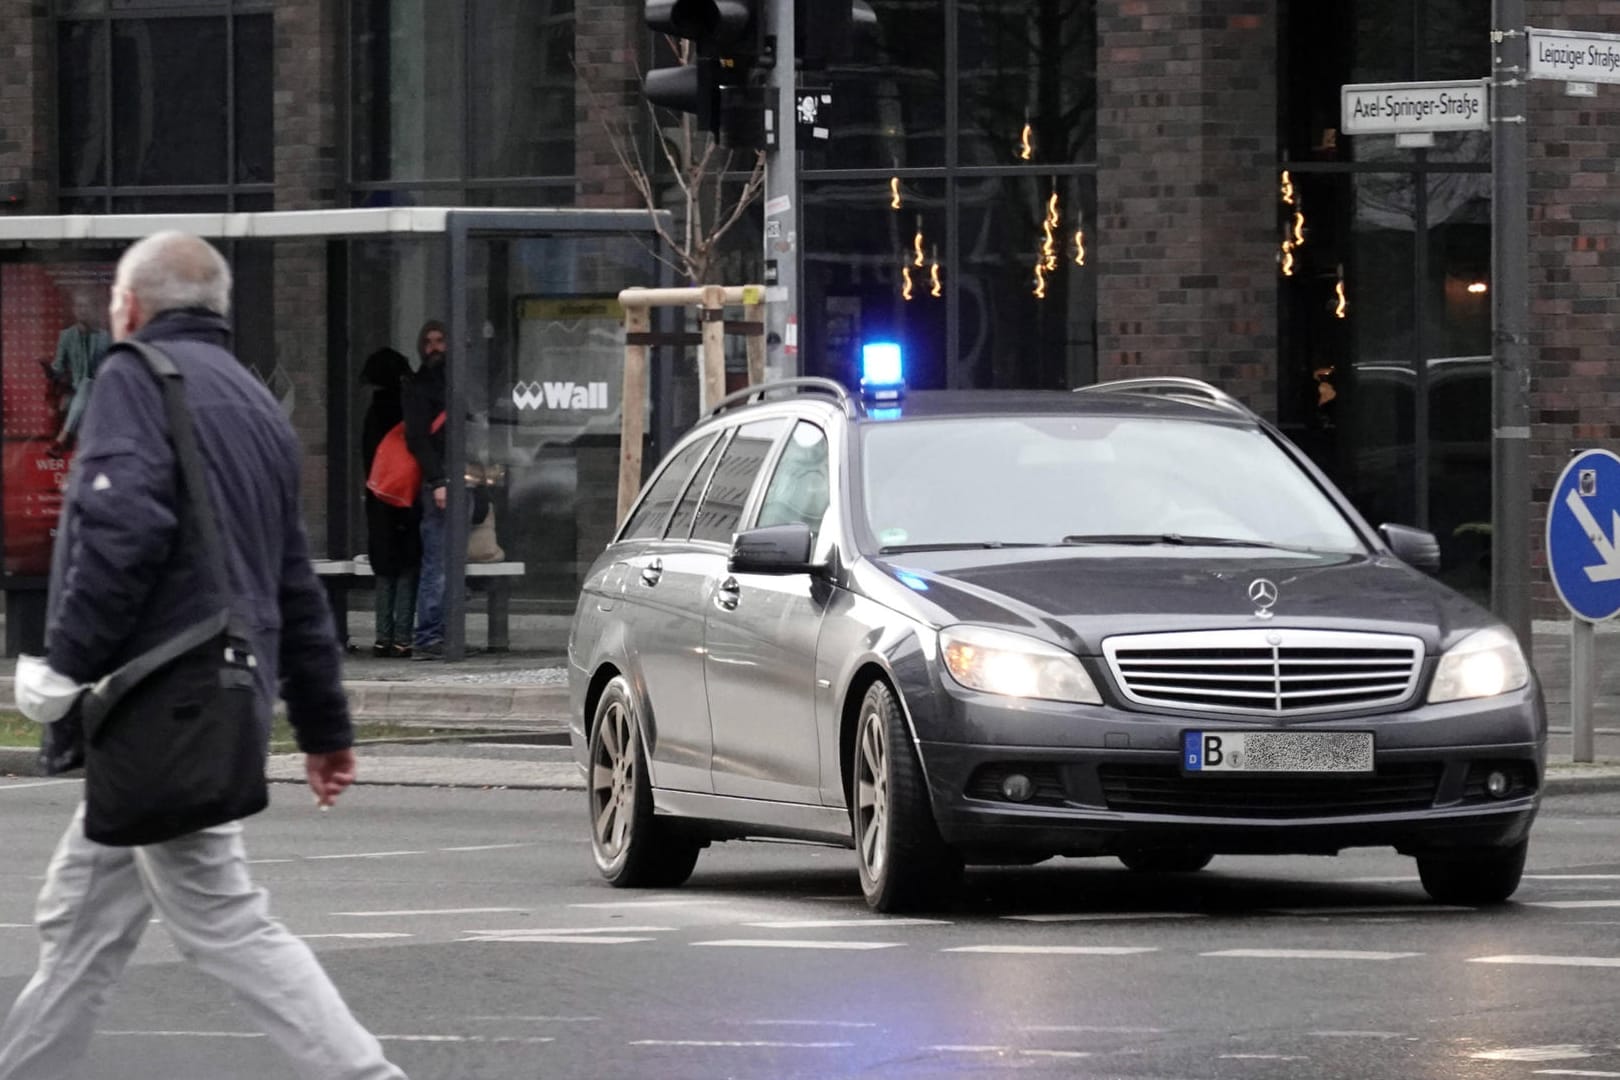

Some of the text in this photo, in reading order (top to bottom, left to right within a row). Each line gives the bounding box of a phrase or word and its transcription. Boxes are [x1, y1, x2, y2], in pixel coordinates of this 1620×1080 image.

[1539, 41, 1620, 72] Leipziger Straße
[1353, 93, 1479, 122] Axel-Springer-Straße
[543, 382, 608, 409] Wall
[36, 459, 65, 471] WER
[1189, 754, 1197, 765] D
[1204, 735, 1223, 766] B
